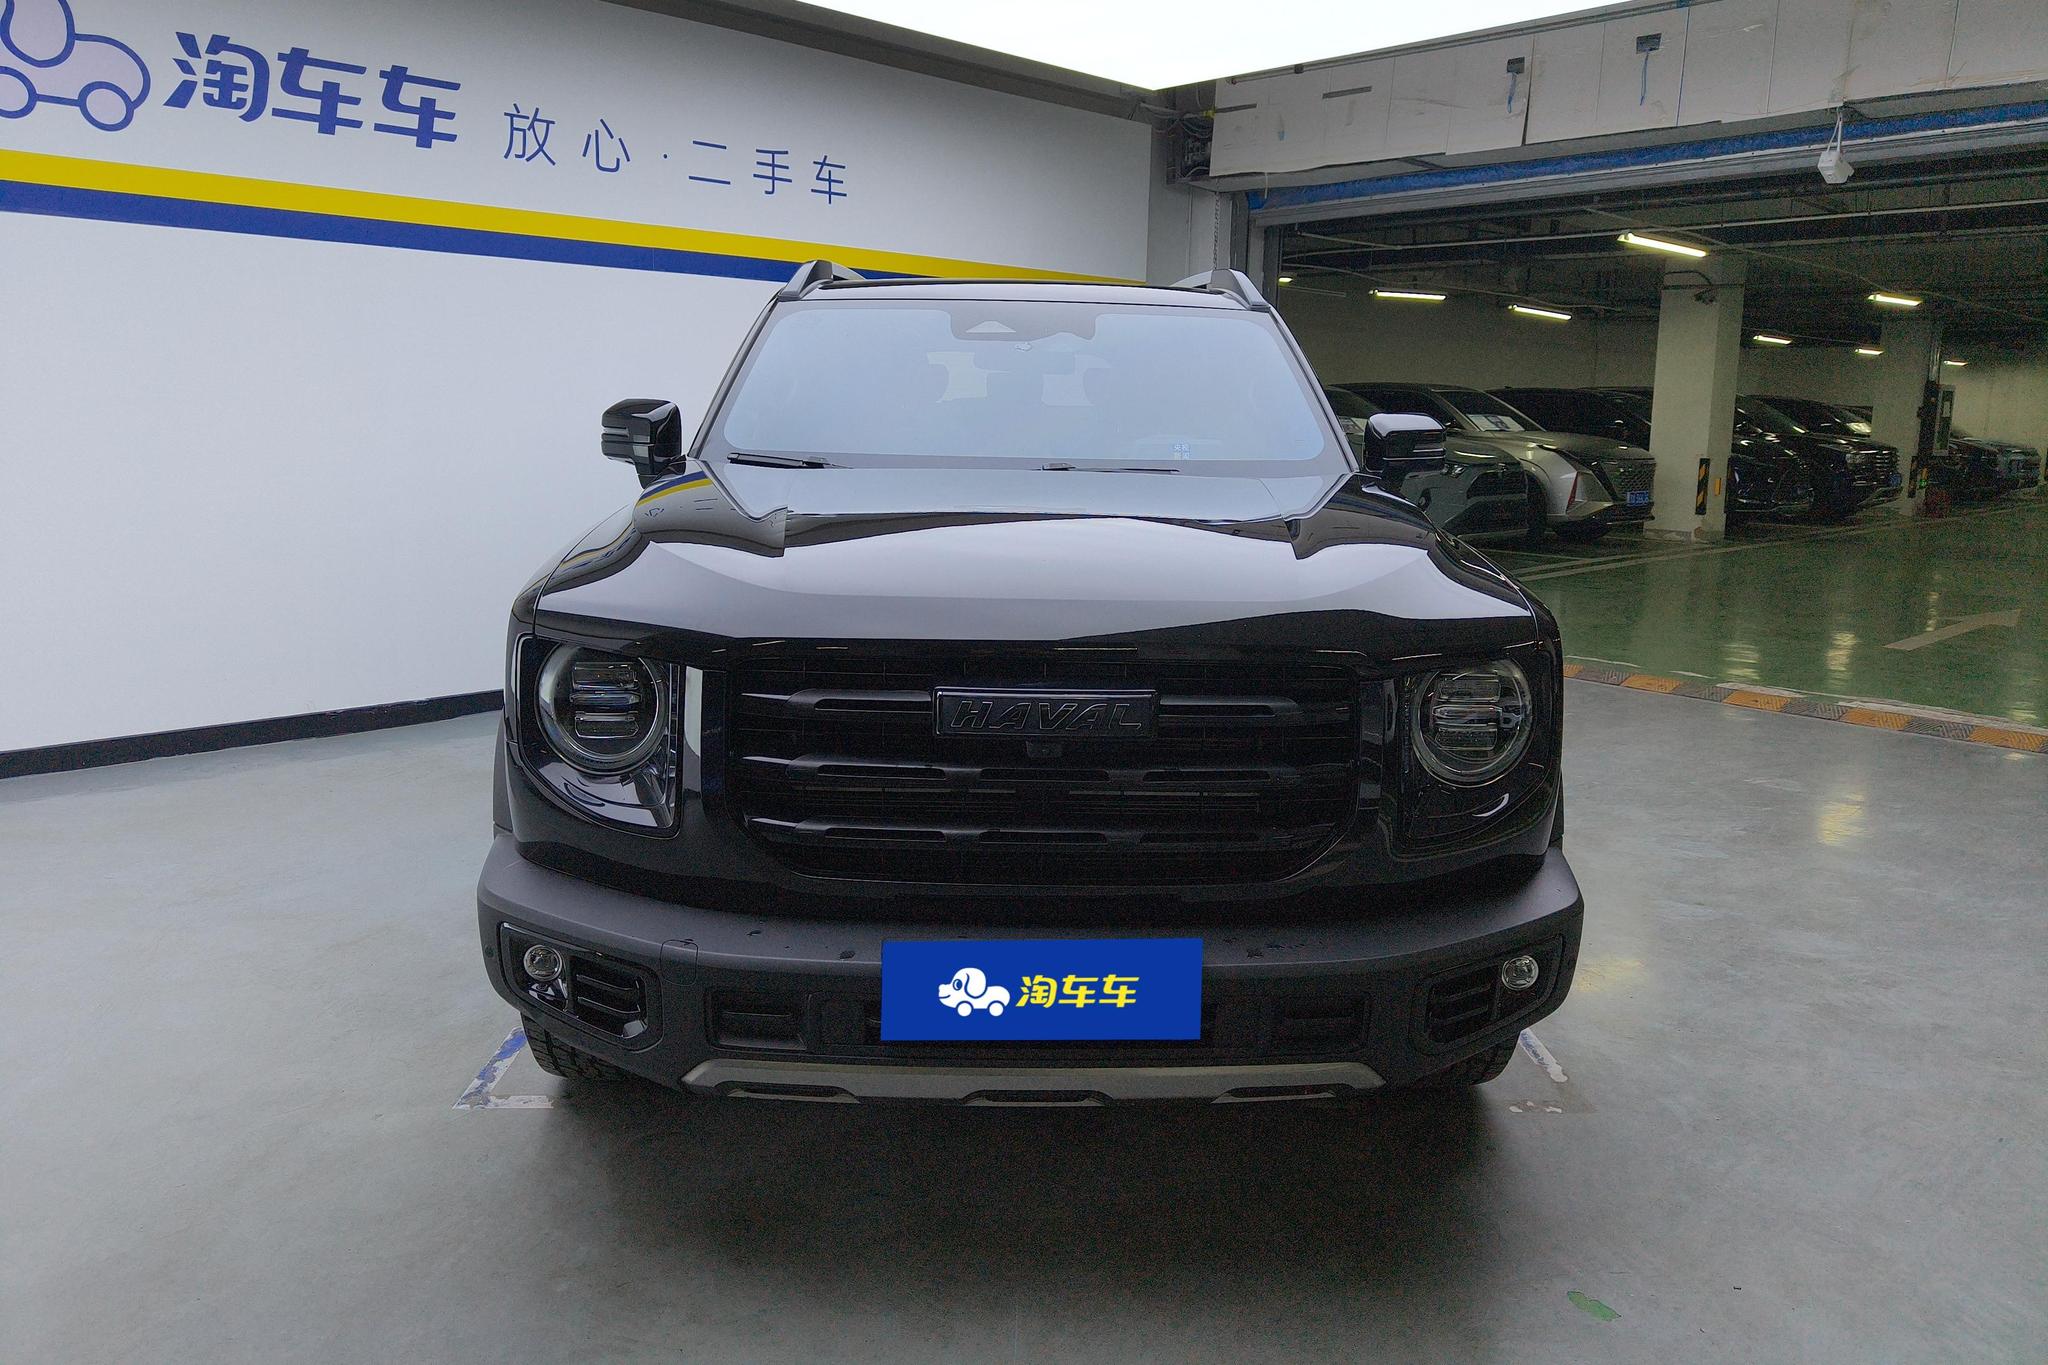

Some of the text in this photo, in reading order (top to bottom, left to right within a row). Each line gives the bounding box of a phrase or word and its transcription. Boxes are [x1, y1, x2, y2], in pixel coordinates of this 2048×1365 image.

[164, 32, 461, 149] 淘车车
[951, 700, 1142, 730] HAVAL
